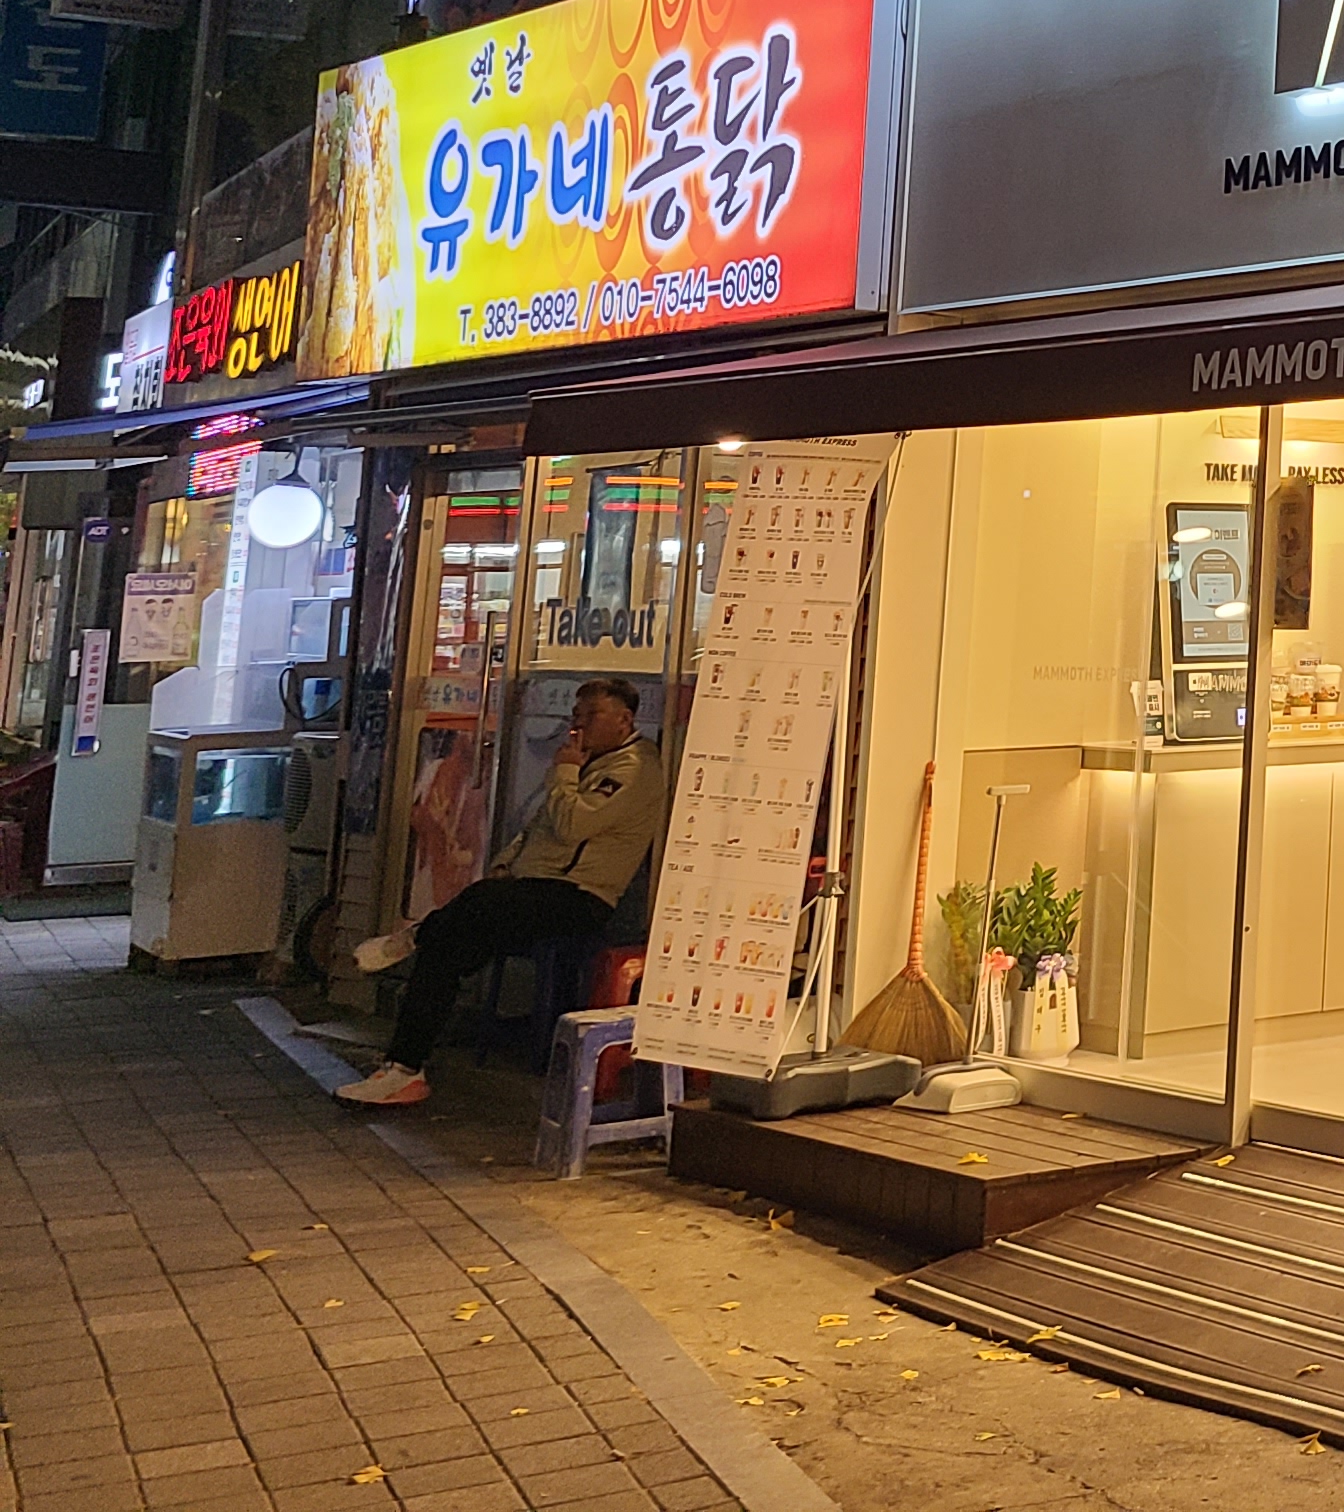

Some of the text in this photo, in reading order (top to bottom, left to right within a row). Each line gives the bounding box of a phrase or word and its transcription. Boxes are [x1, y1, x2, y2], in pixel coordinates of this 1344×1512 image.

[469, 32, 531, 105] 옛날
[422, 33, 797, 273] 유가네 통닭
[484, 293, 577, 339] 383-8892
[601, 258, 778, 323] 010-7544-6098
[1204, 463, 1239, 482] TAKE
[87, 526, 110, 536] ADT
[1033, 665, 1094, 681] MAMMOTH
[1198, 674, 1247, 692] MAMMO
